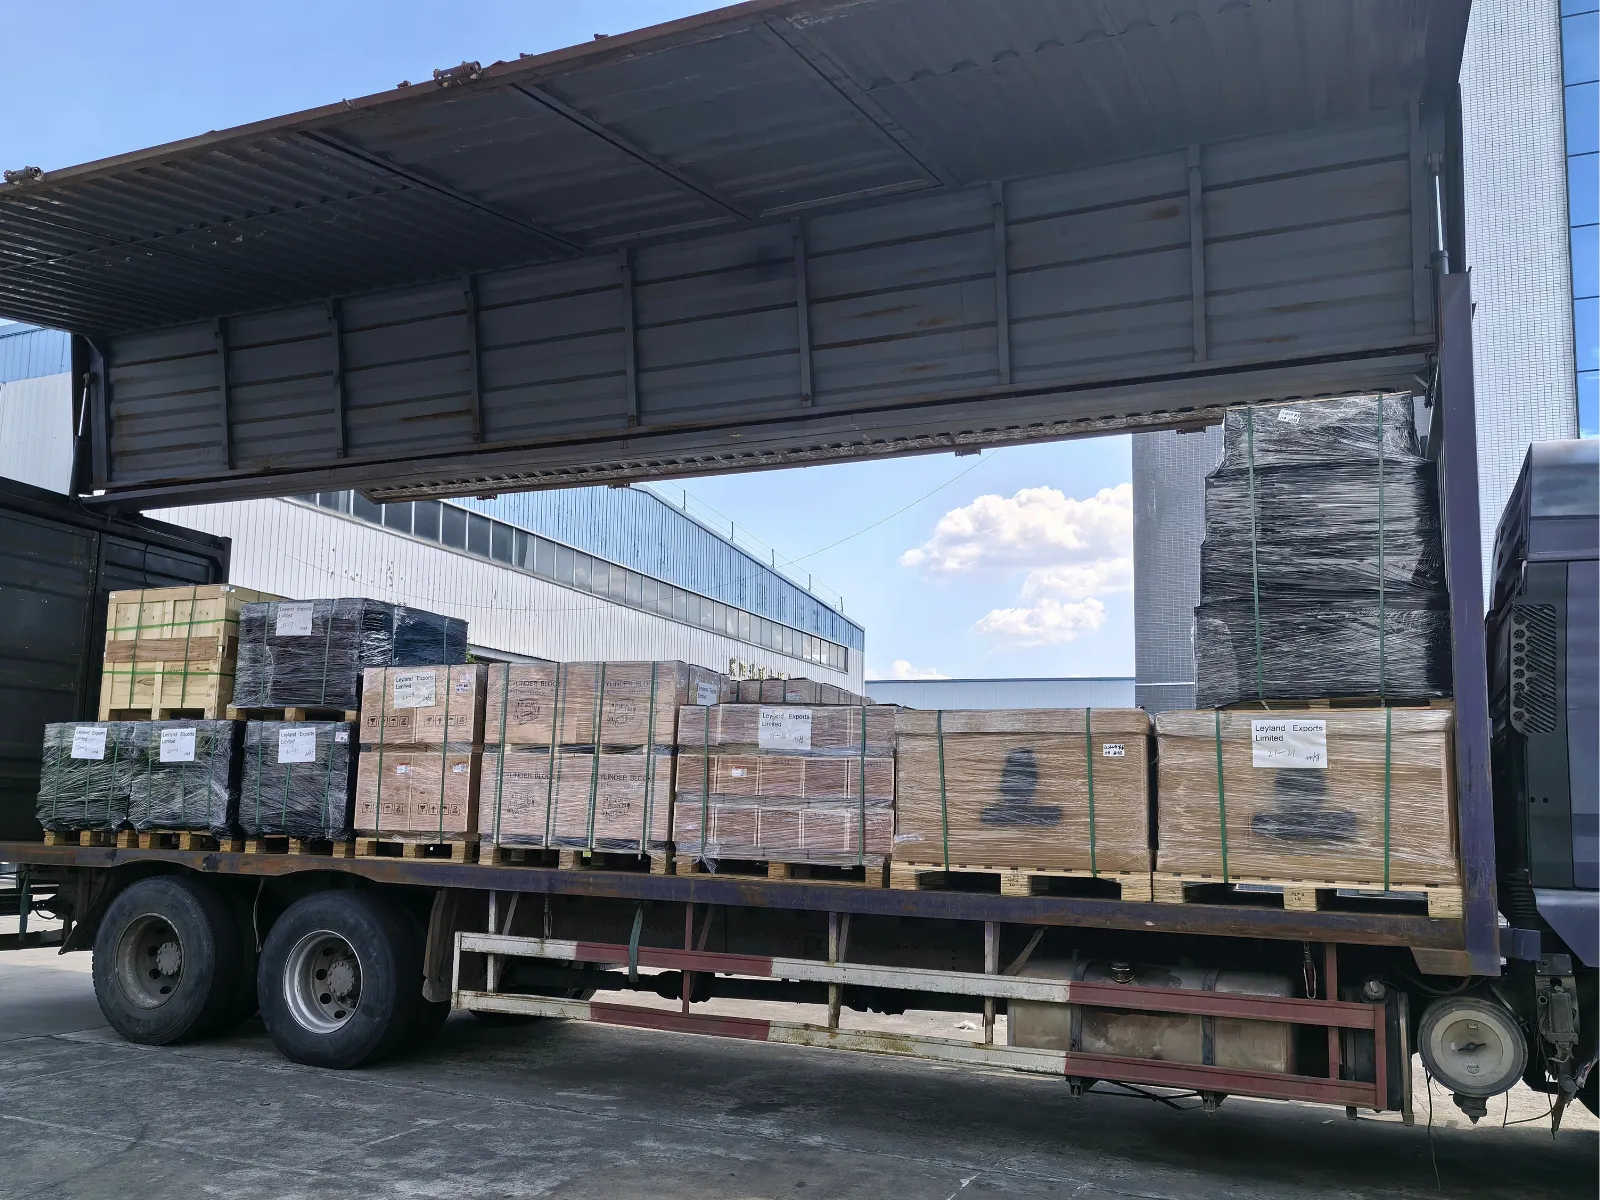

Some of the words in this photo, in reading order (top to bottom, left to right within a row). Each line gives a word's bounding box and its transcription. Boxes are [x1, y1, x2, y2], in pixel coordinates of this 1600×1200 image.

[788, 712, 810, 720] Exports
[1255, 724, 1286, 733] Leyland
[1292, 724, 1323, 733] Exports
[1255, 734, 1284, 742] Limited
